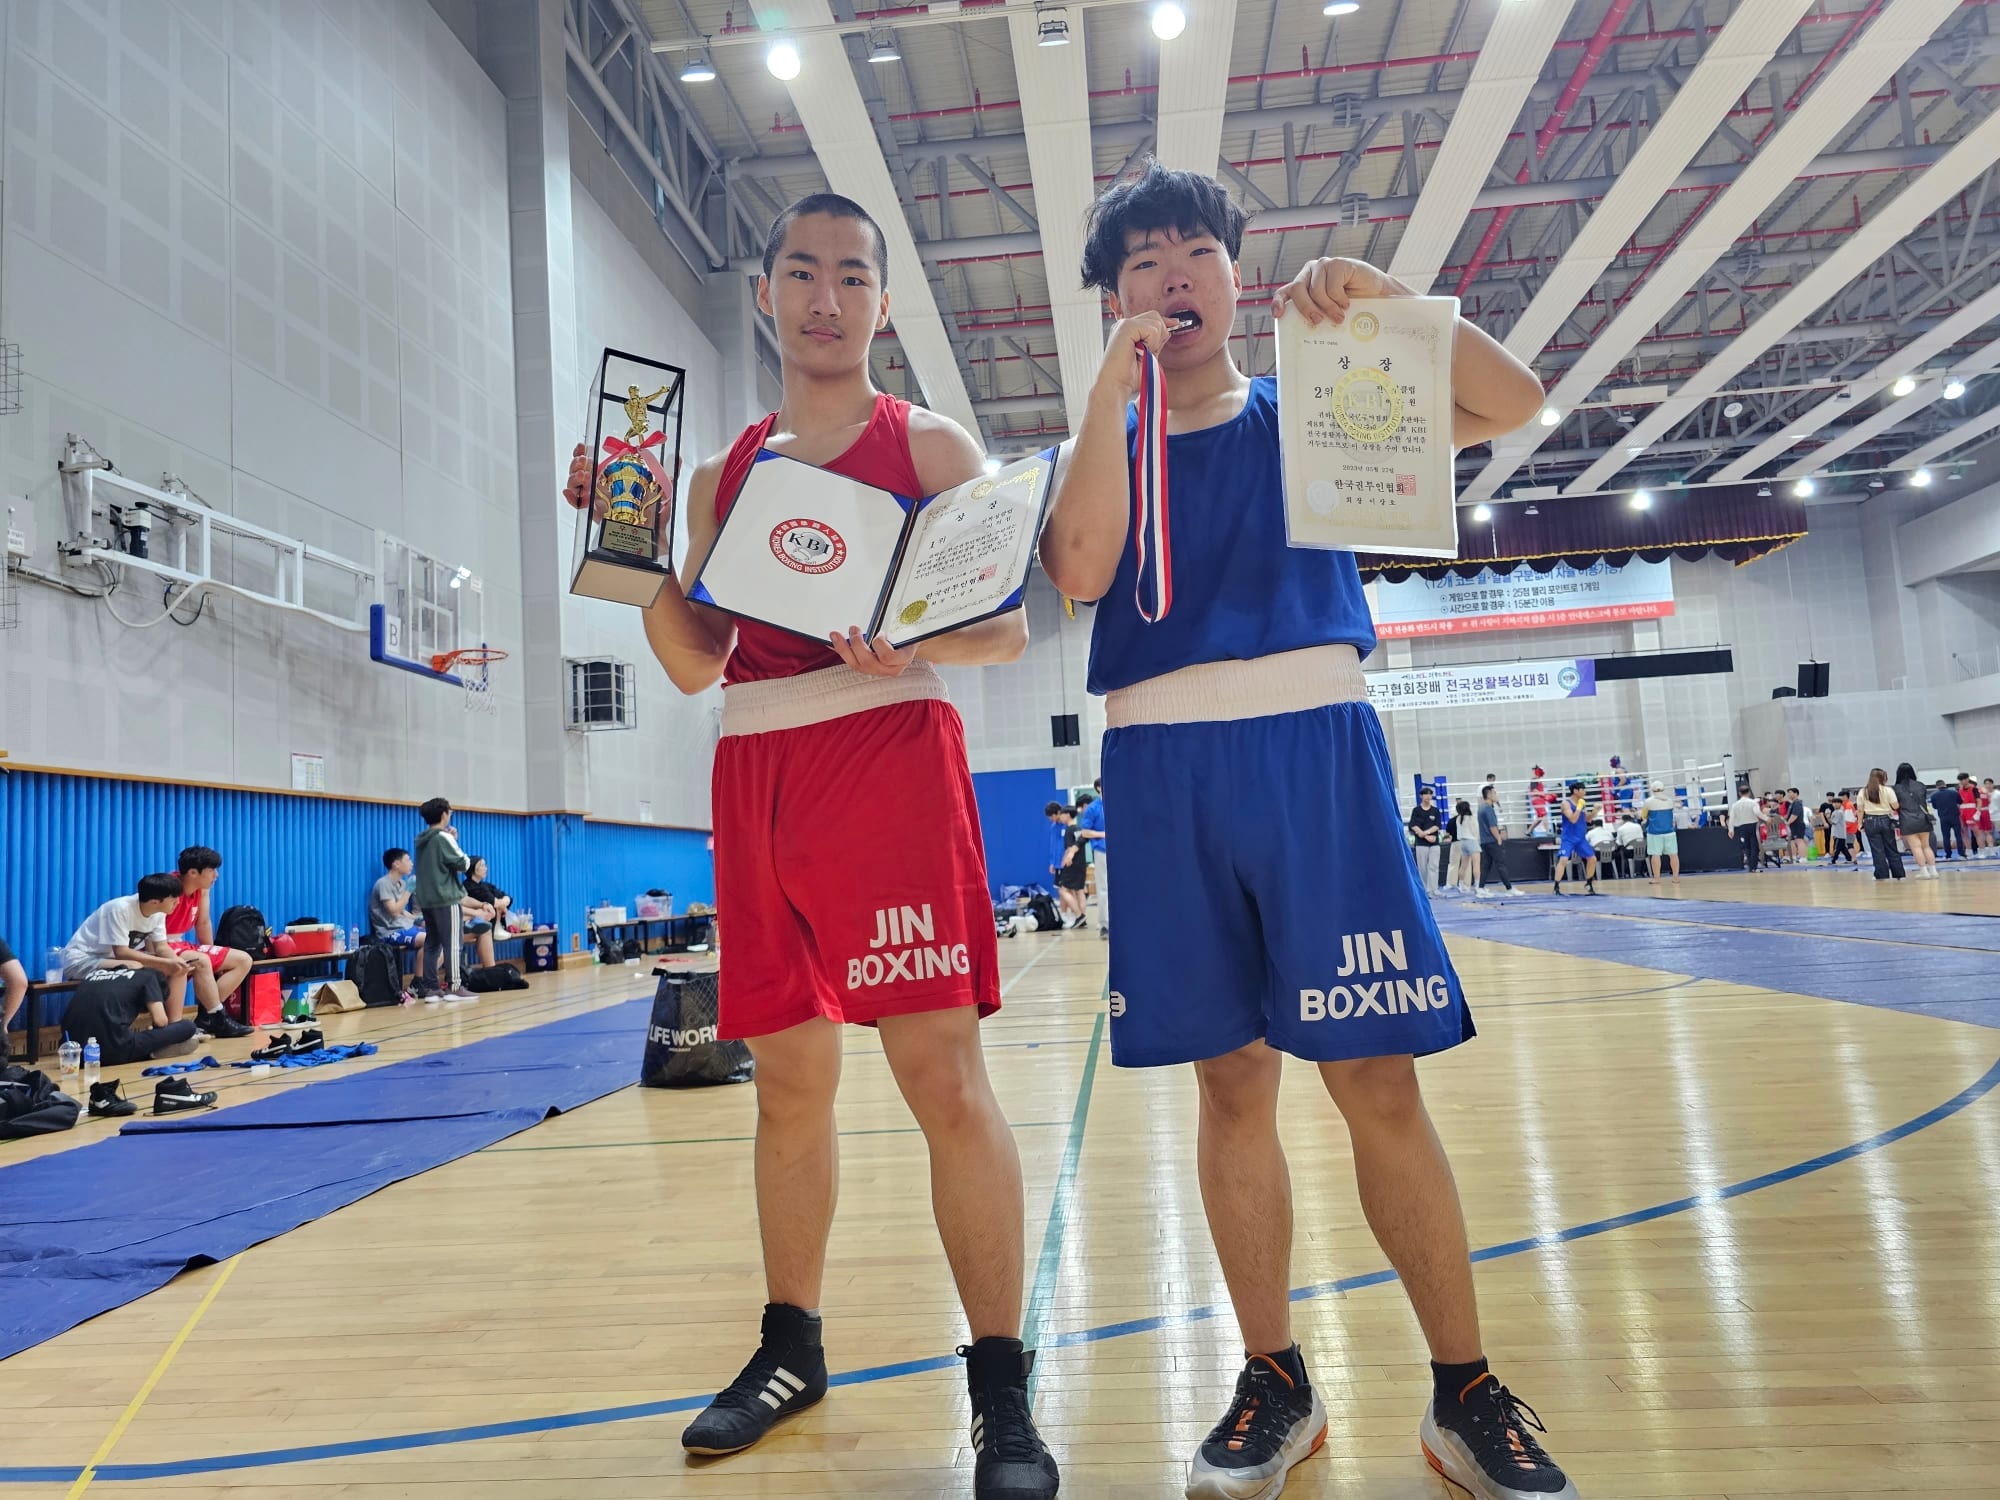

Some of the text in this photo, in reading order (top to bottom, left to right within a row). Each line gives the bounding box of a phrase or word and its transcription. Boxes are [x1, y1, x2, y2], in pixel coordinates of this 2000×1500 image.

[1337, 355, 1392, 372] 상 장
[788, 532, 831, 555] KBI
[778, 552, 803, 571] BOXING
[1449, 603, 1480, 614] 시간으로
[1446, 672, 1550, 693] 전국생활복싱대회
[869, 903, 935, 949] JIN
[1336, 929, 1409, 977] JIN
[847, 943, 971, 990] BOXING
[1299, 974, 1450, 1022] BOXING
